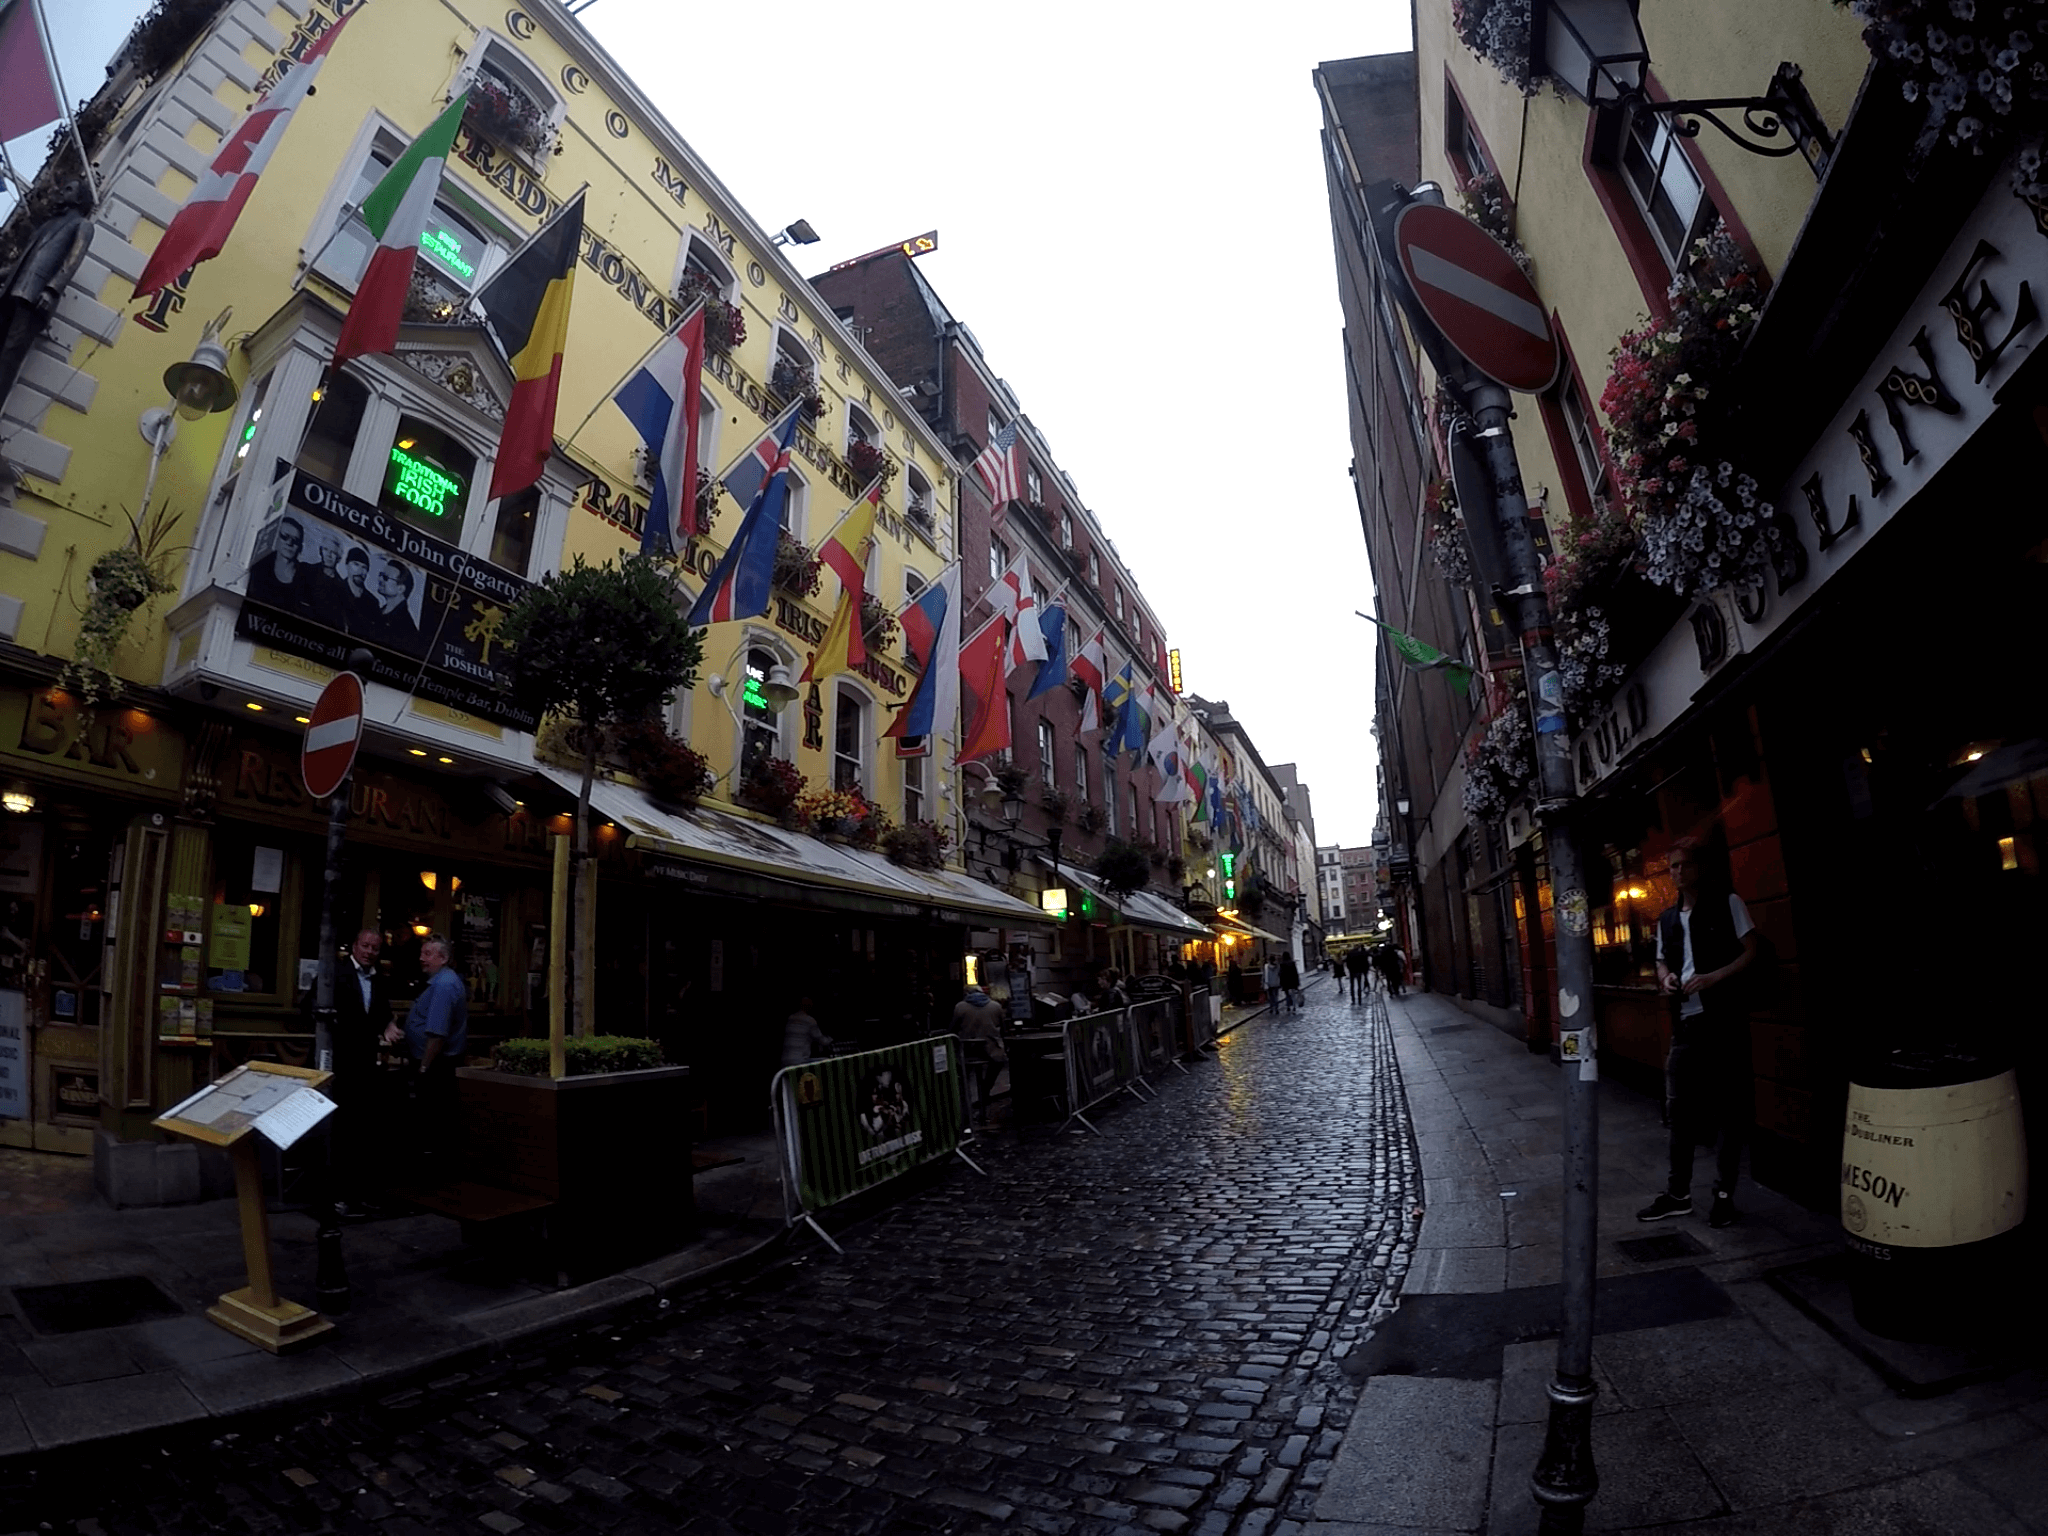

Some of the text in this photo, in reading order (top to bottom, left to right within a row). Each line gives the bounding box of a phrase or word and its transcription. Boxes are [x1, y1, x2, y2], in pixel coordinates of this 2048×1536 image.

[391, 448, 460, 496] TRADITIONAL
[400, 466, 446, 502] IRISH
[394, 481, 444, 516] FOOD
[304, 482, 370, 528] Oliver
[372, 515, 396, 544] St.
[397, 529, 445, 568] John
[430, 581, 462, 611] U2
[775, 596, 830, 648] IRIS
[444, 642, 465, 657] THE
[247, 612, 326, 654] Welcomes
[326, 645, 347, 661] all
[371, 659, 400, 680] fans
[402, 670, 417, 685] to
[418, 674, 466, 702] Temple
[465, 693, 492, 713] Bar,
[494, 701, 535, 726] Dublin
[443, 654, 496, 683] JOSHUA
[17, 690, 141, 775] BAR
[1578, 682, 1648, 787] AULD
[1853, 1110, 1871, 1123] THE
[1851, 1124, 1915, 1148] DUBLINER
